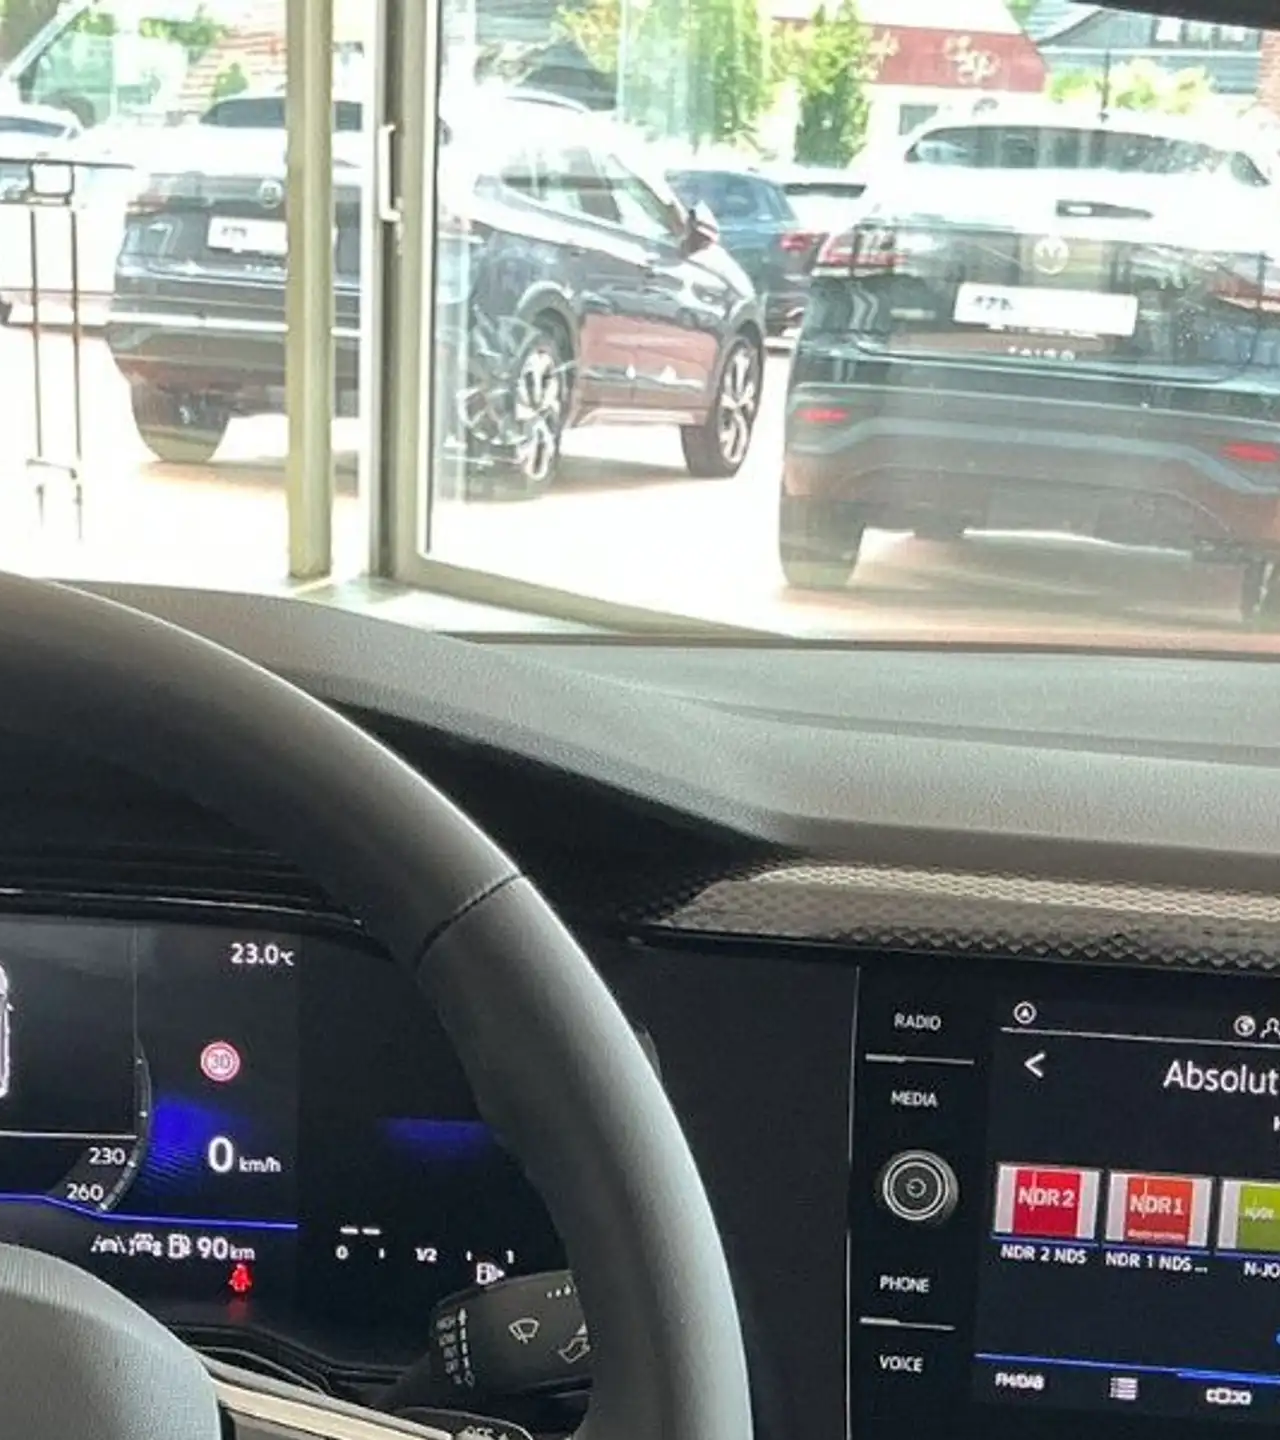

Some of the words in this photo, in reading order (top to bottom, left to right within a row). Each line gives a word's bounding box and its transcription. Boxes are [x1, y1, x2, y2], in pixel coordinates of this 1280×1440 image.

[894, 1013, 942, 1031] RADIO
[1163, 1060, 1279, 1096] Absolut
[891, 1091, 937, 1108] MEDIA
[88, 1147, 125, 1166] 230
[208, 1137, 233, 1173] 0
[239, 1155, 282, 1175] km/h
[66, 1182, 104, 1202] 260
[1018, 1187, 1061, 1208] NDR
[1061, 1189, 1075, 1208] 2
[1129, 1195, 1172, 1216] NDR
[336, 1246, 349, 1261] 0
[506, 1251, 515, 1264] 1
[1001, 1244, 1036, 1261] NDR
[1040, 1247, 1051, 1261] 2
[1053, 1248, 1087, 1264] NDS
[1105, 1252, 1142, 1268] NDR
[1147, 1254, 1155, 1268] 1
[1159, 1256, 1192, 1271] NDS
[879, 1275, 930, 1293] PHONE
[879, 1355, 924, 1373] VOICE
